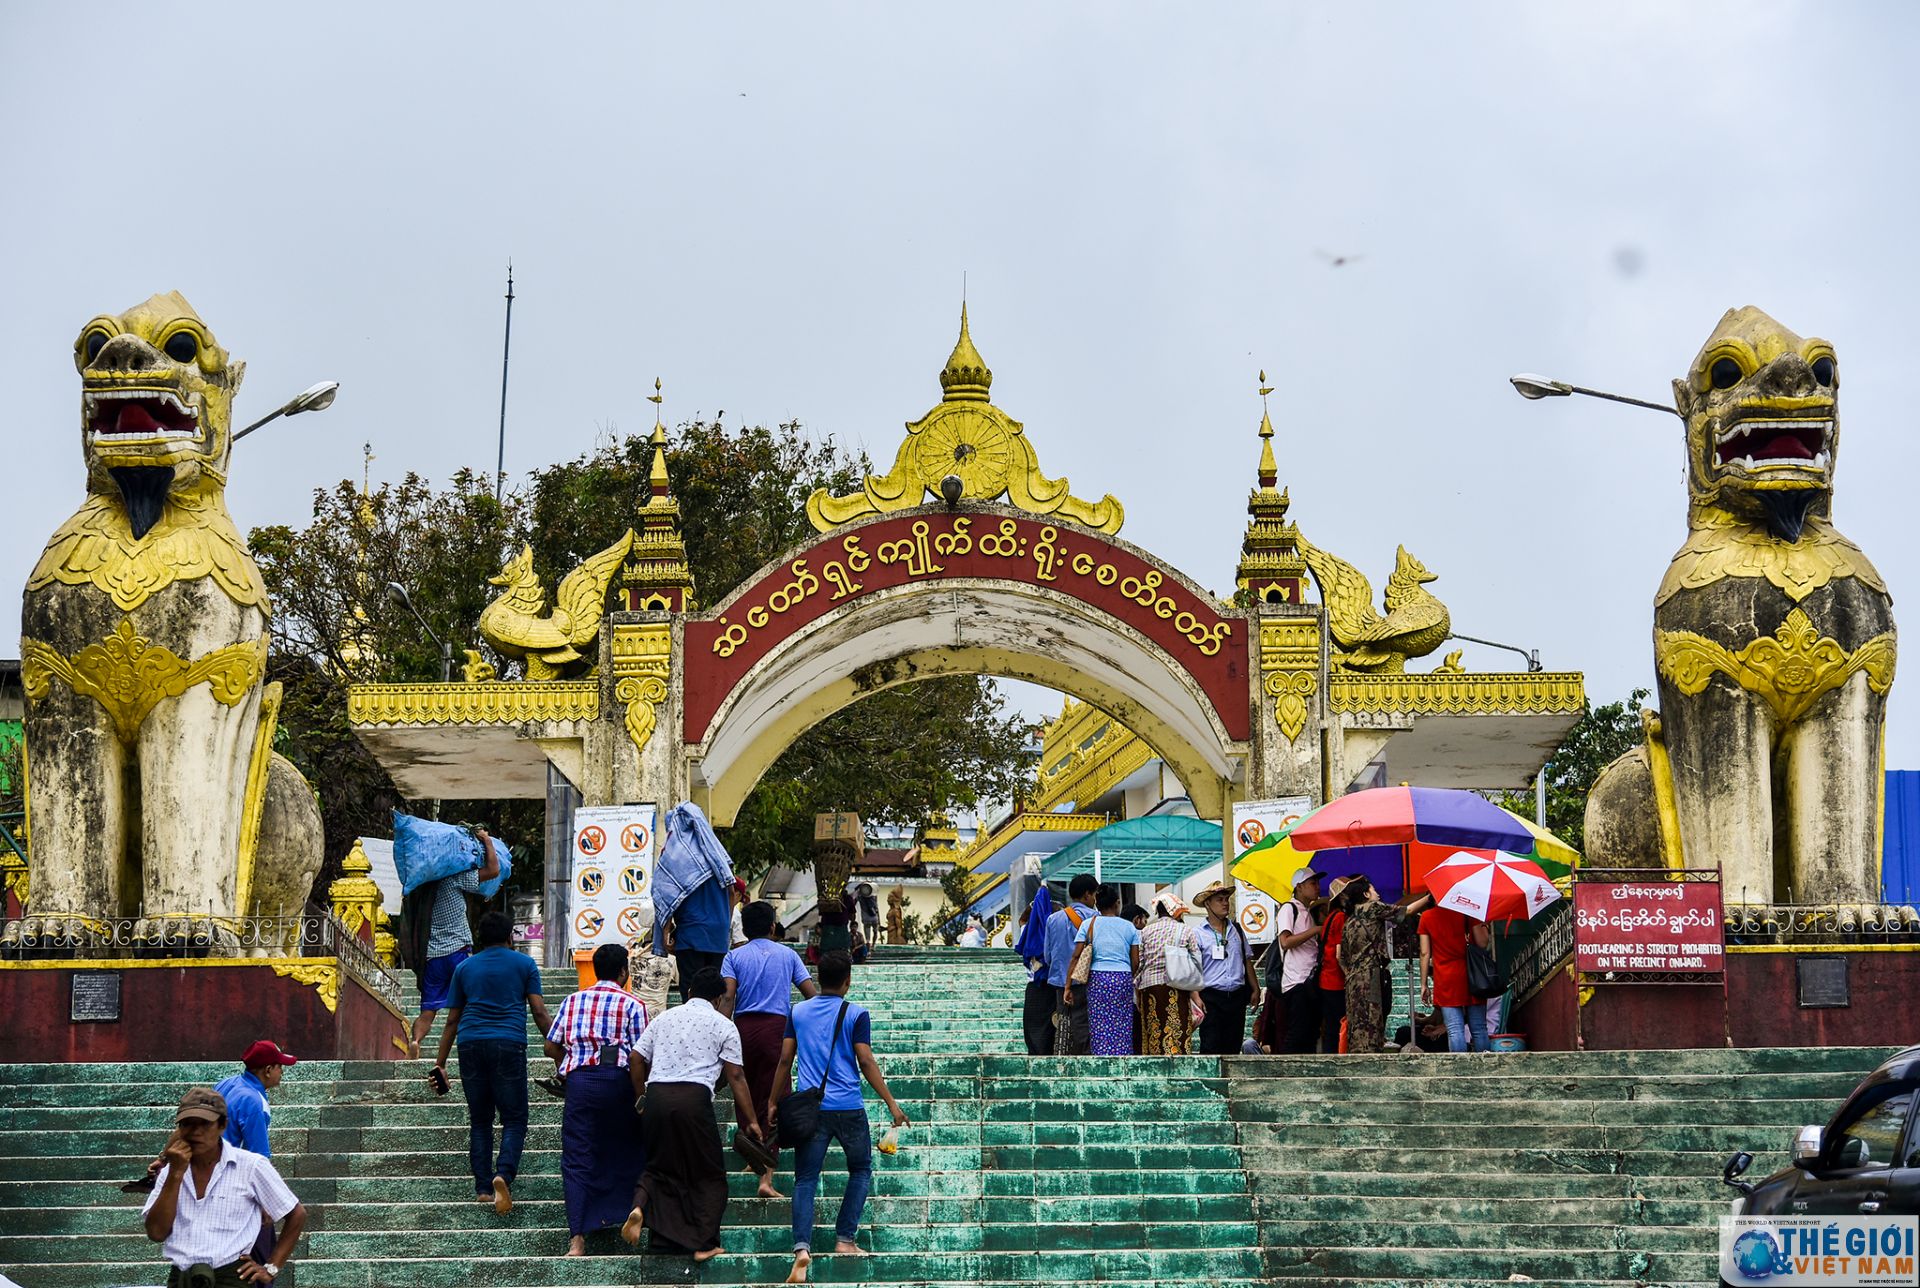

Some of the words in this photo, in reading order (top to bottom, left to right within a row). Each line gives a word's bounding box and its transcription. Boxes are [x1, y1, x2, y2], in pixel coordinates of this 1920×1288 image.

[1578, 943, 1633, 955] FOOTWEARING
[1636, 943, 1645, 955] IS
[1681, 943, 1722, 955] PROHIBITED
[1598, 957, 1610, 968] ON
[1612, 956, 1627, 968] THE
[1629, 956, 1666, 968] PRECINCT
[1669, 957, 1707, 968] ONWARD.
